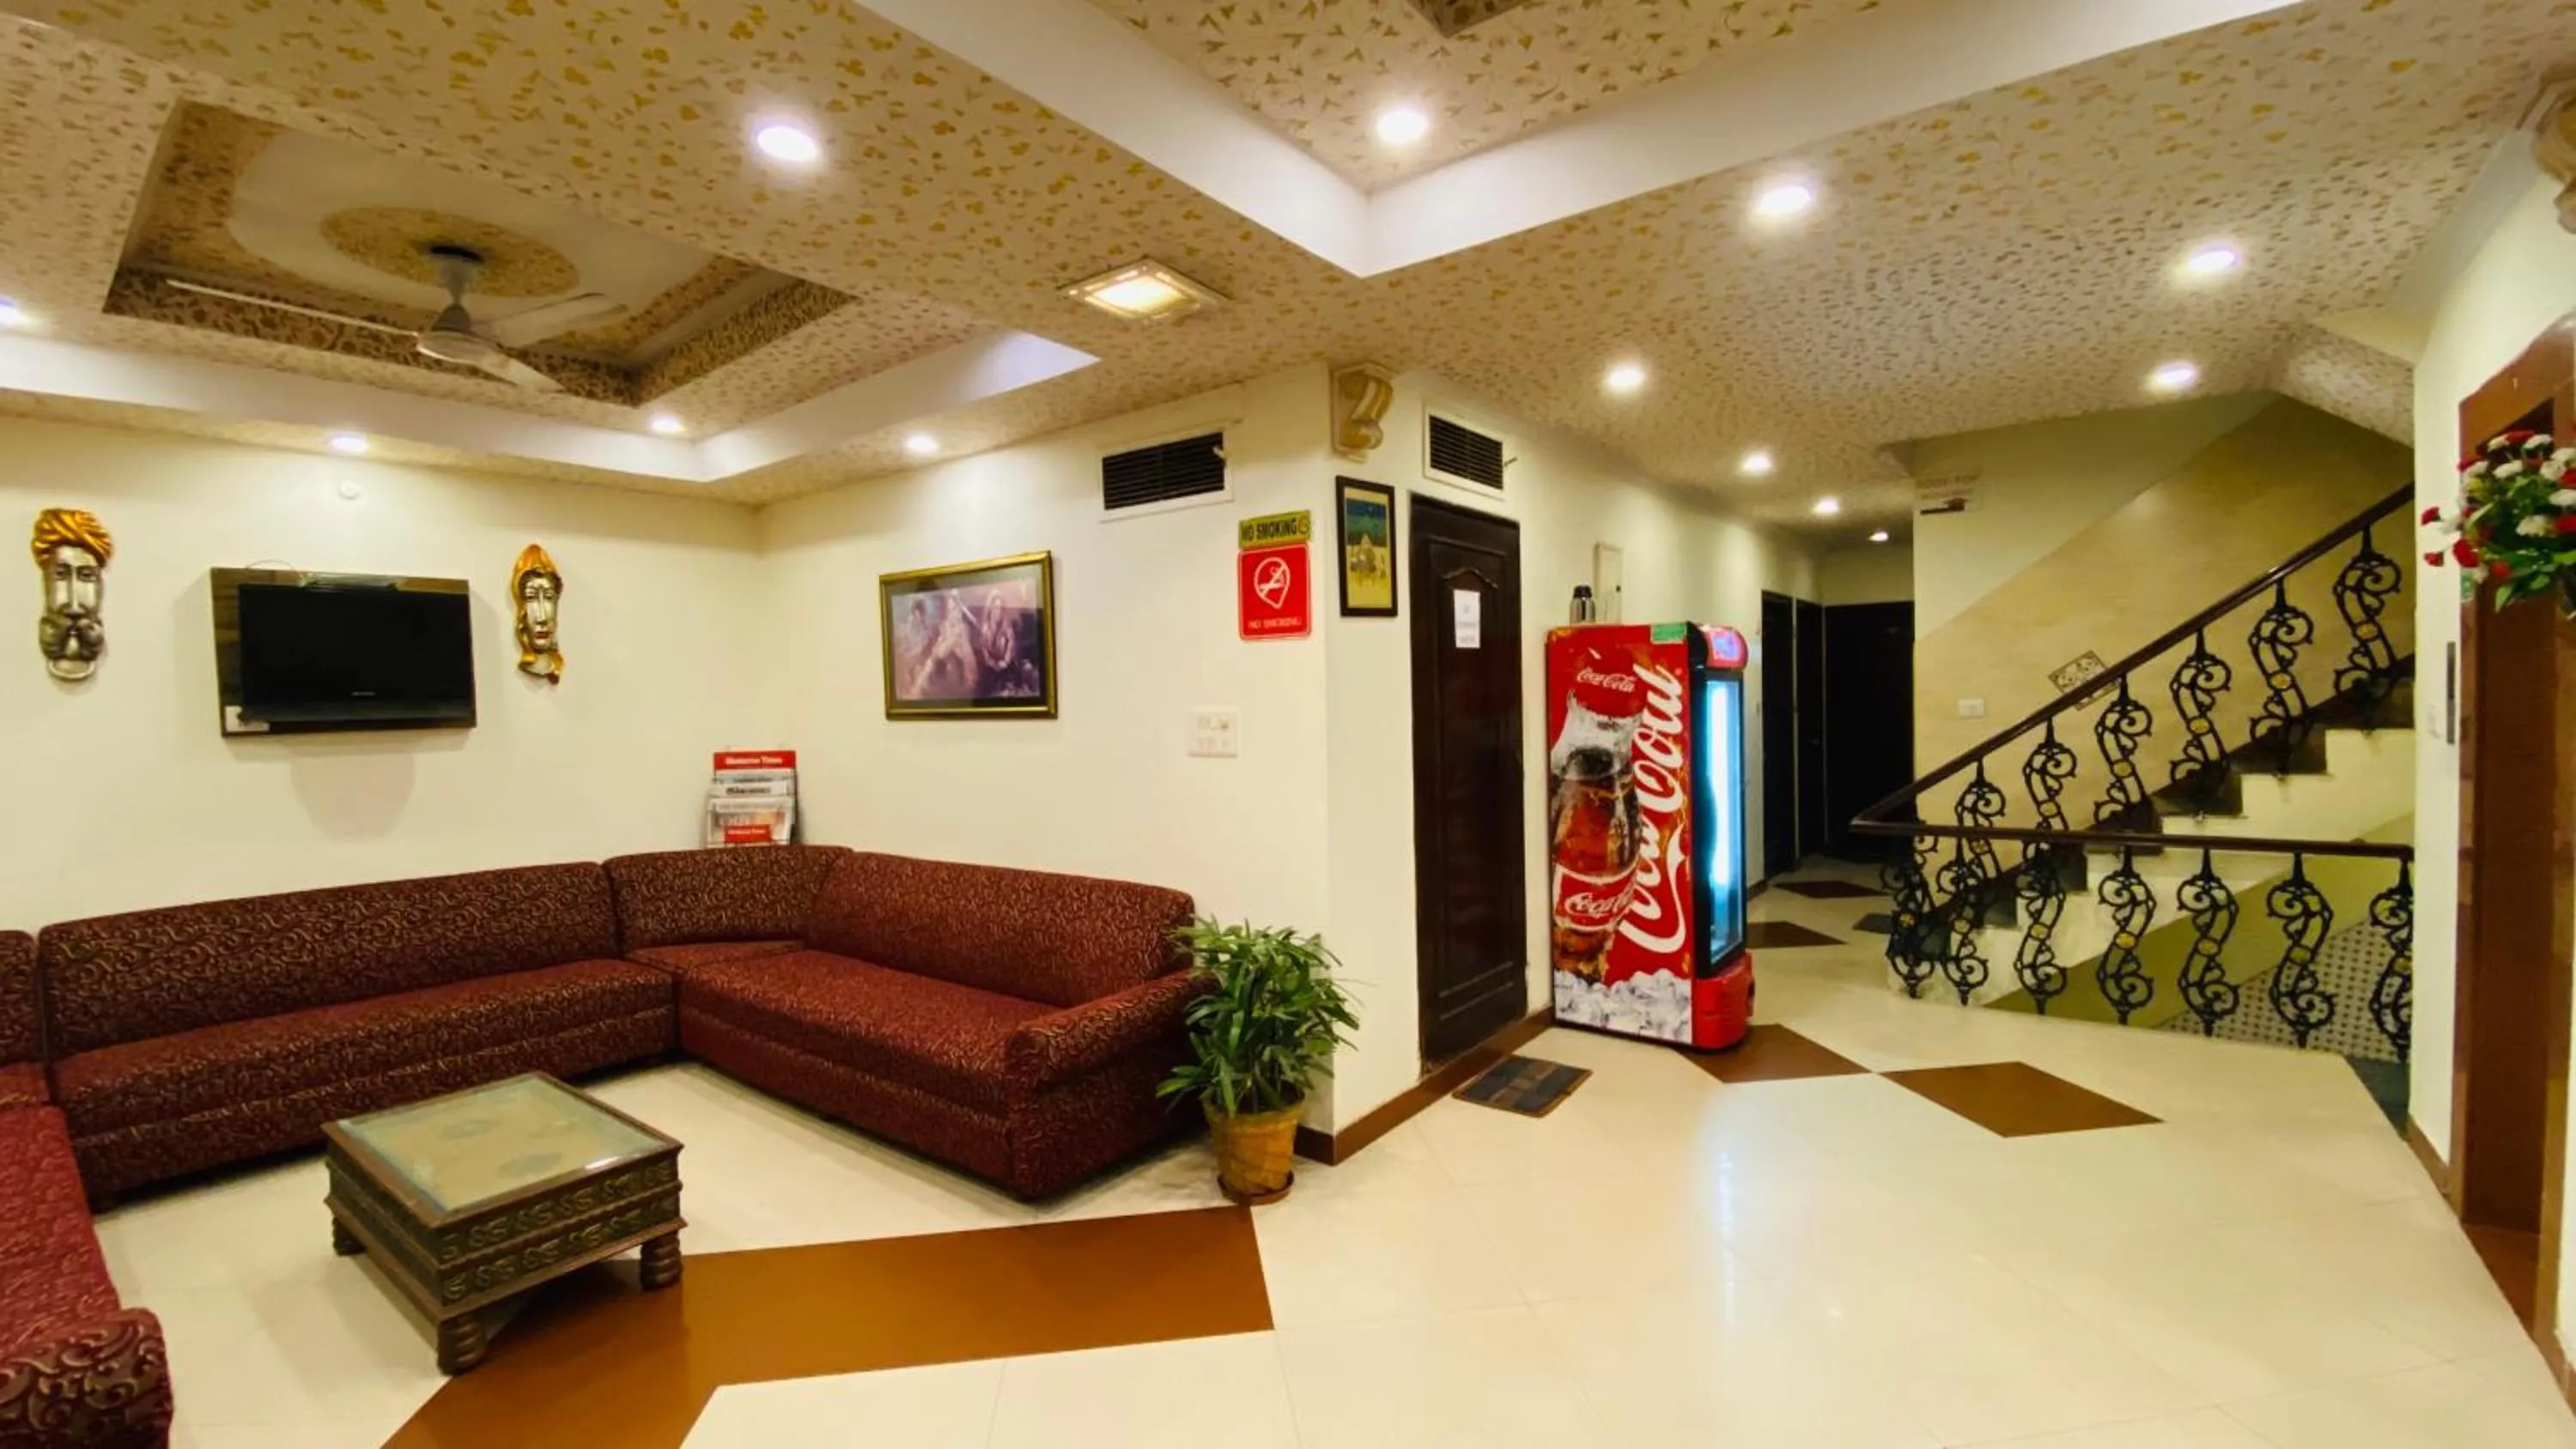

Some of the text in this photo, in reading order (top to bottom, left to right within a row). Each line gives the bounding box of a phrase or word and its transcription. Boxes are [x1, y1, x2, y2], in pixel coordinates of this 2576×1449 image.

[1242, 518, 1297, 542] NO SMOKING
[1248, 616, 1303, 629] NO SMOKING
